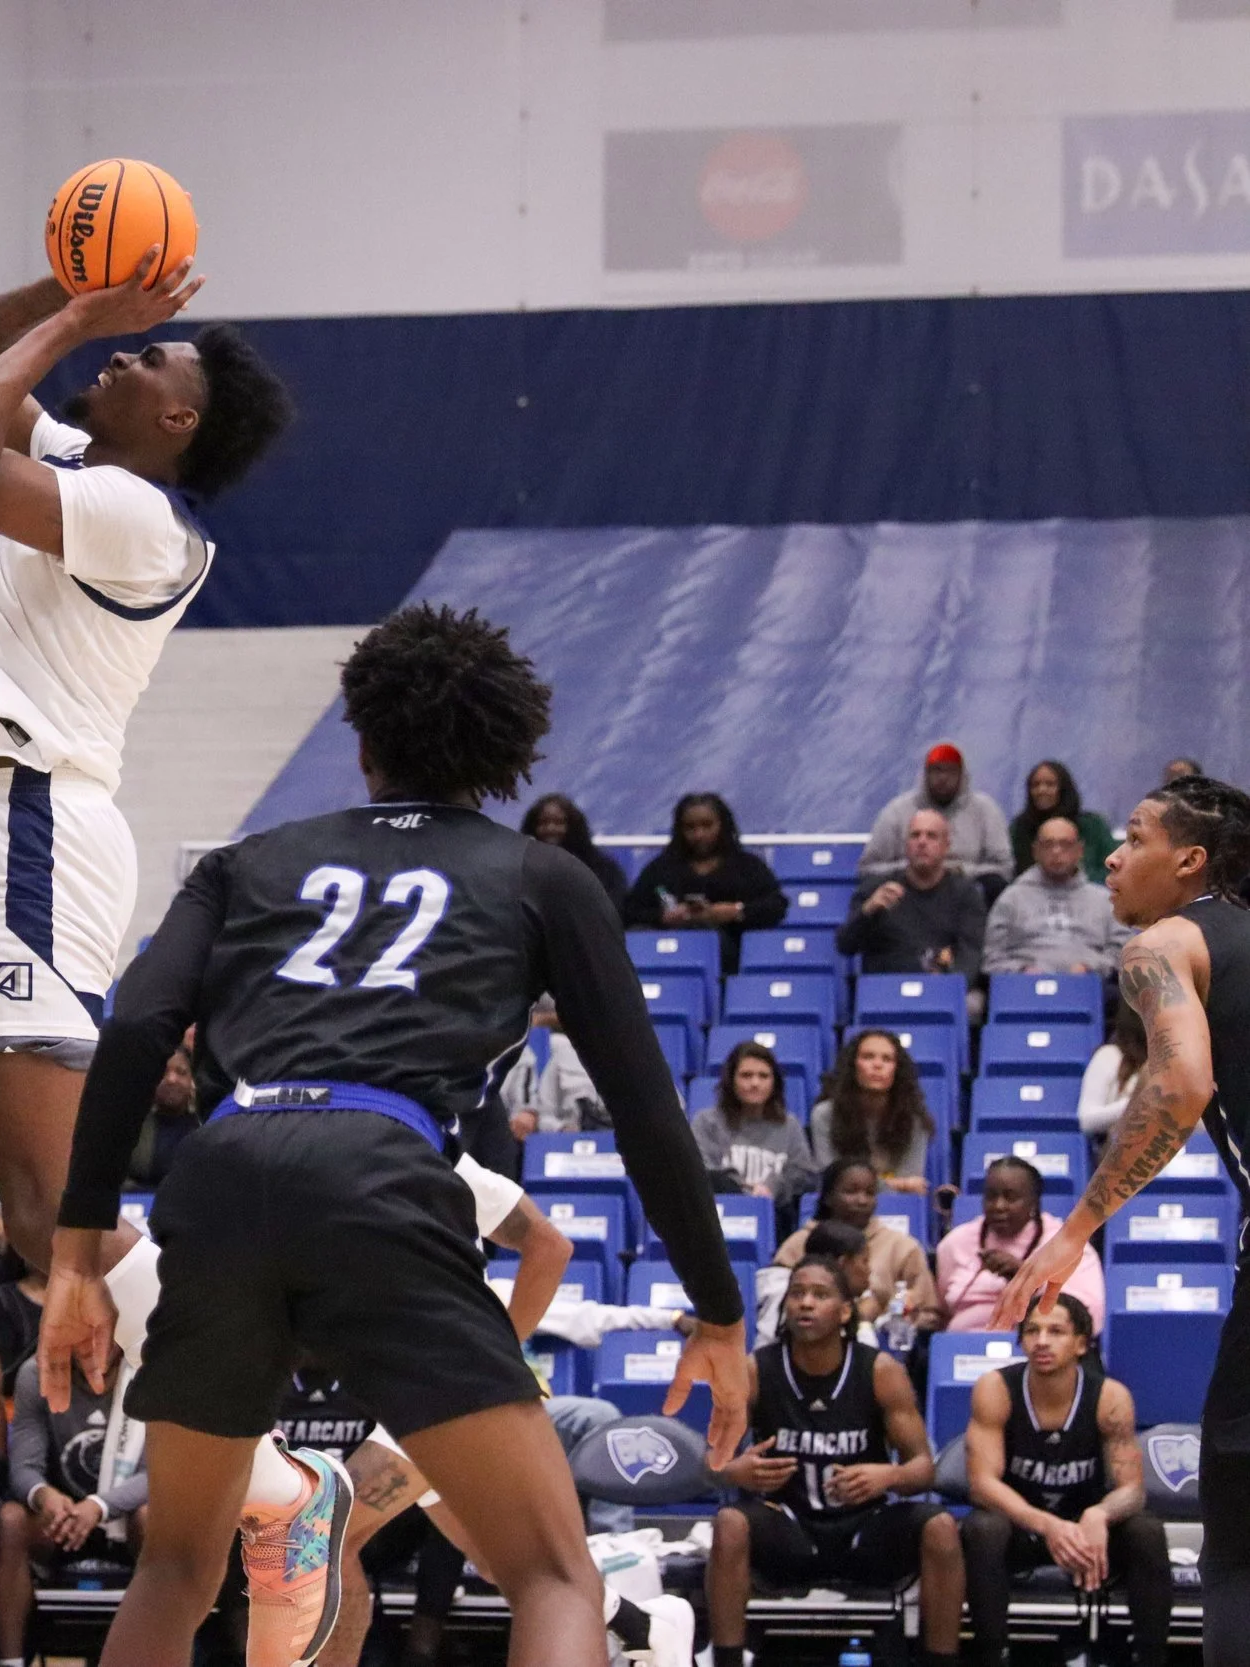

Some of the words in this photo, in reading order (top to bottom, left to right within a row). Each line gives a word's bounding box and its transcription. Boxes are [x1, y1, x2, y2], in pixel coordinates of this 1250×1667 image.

[70, 183, 108, 283] Wilson
[275, 863, 453, 993] 22
[776, 1427, 869, 1455] BEARCATS
